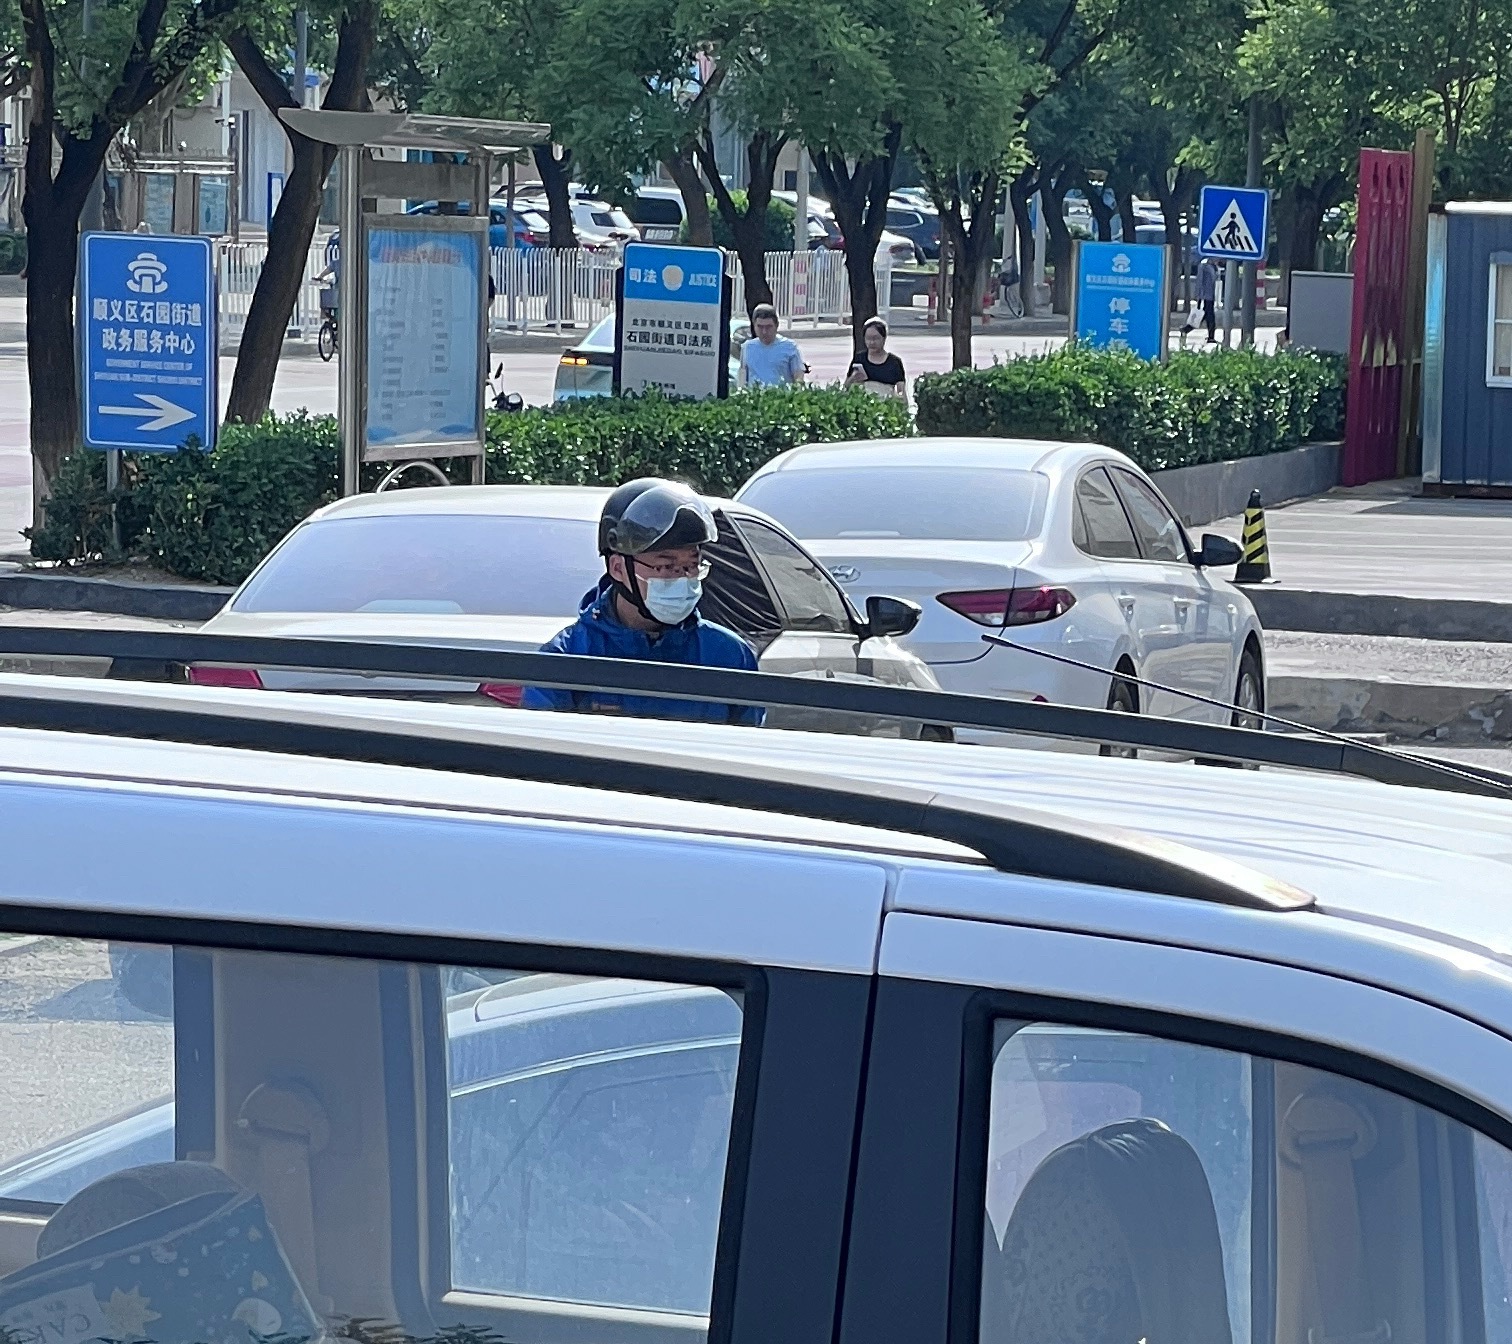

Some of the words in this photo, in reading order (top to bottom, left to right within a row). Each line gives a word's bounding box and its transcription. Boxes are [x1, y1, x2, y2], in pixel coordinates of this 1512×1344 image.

[628, 267, 657, 284] 司法
[688, 273, 717, 287] JUSTICE
[93, 297, 202, 326] 顺义区石园街道
[102, 327, 196, 355] 政务服务中心
[626, 331, 713, 348] 石园街道司法所
